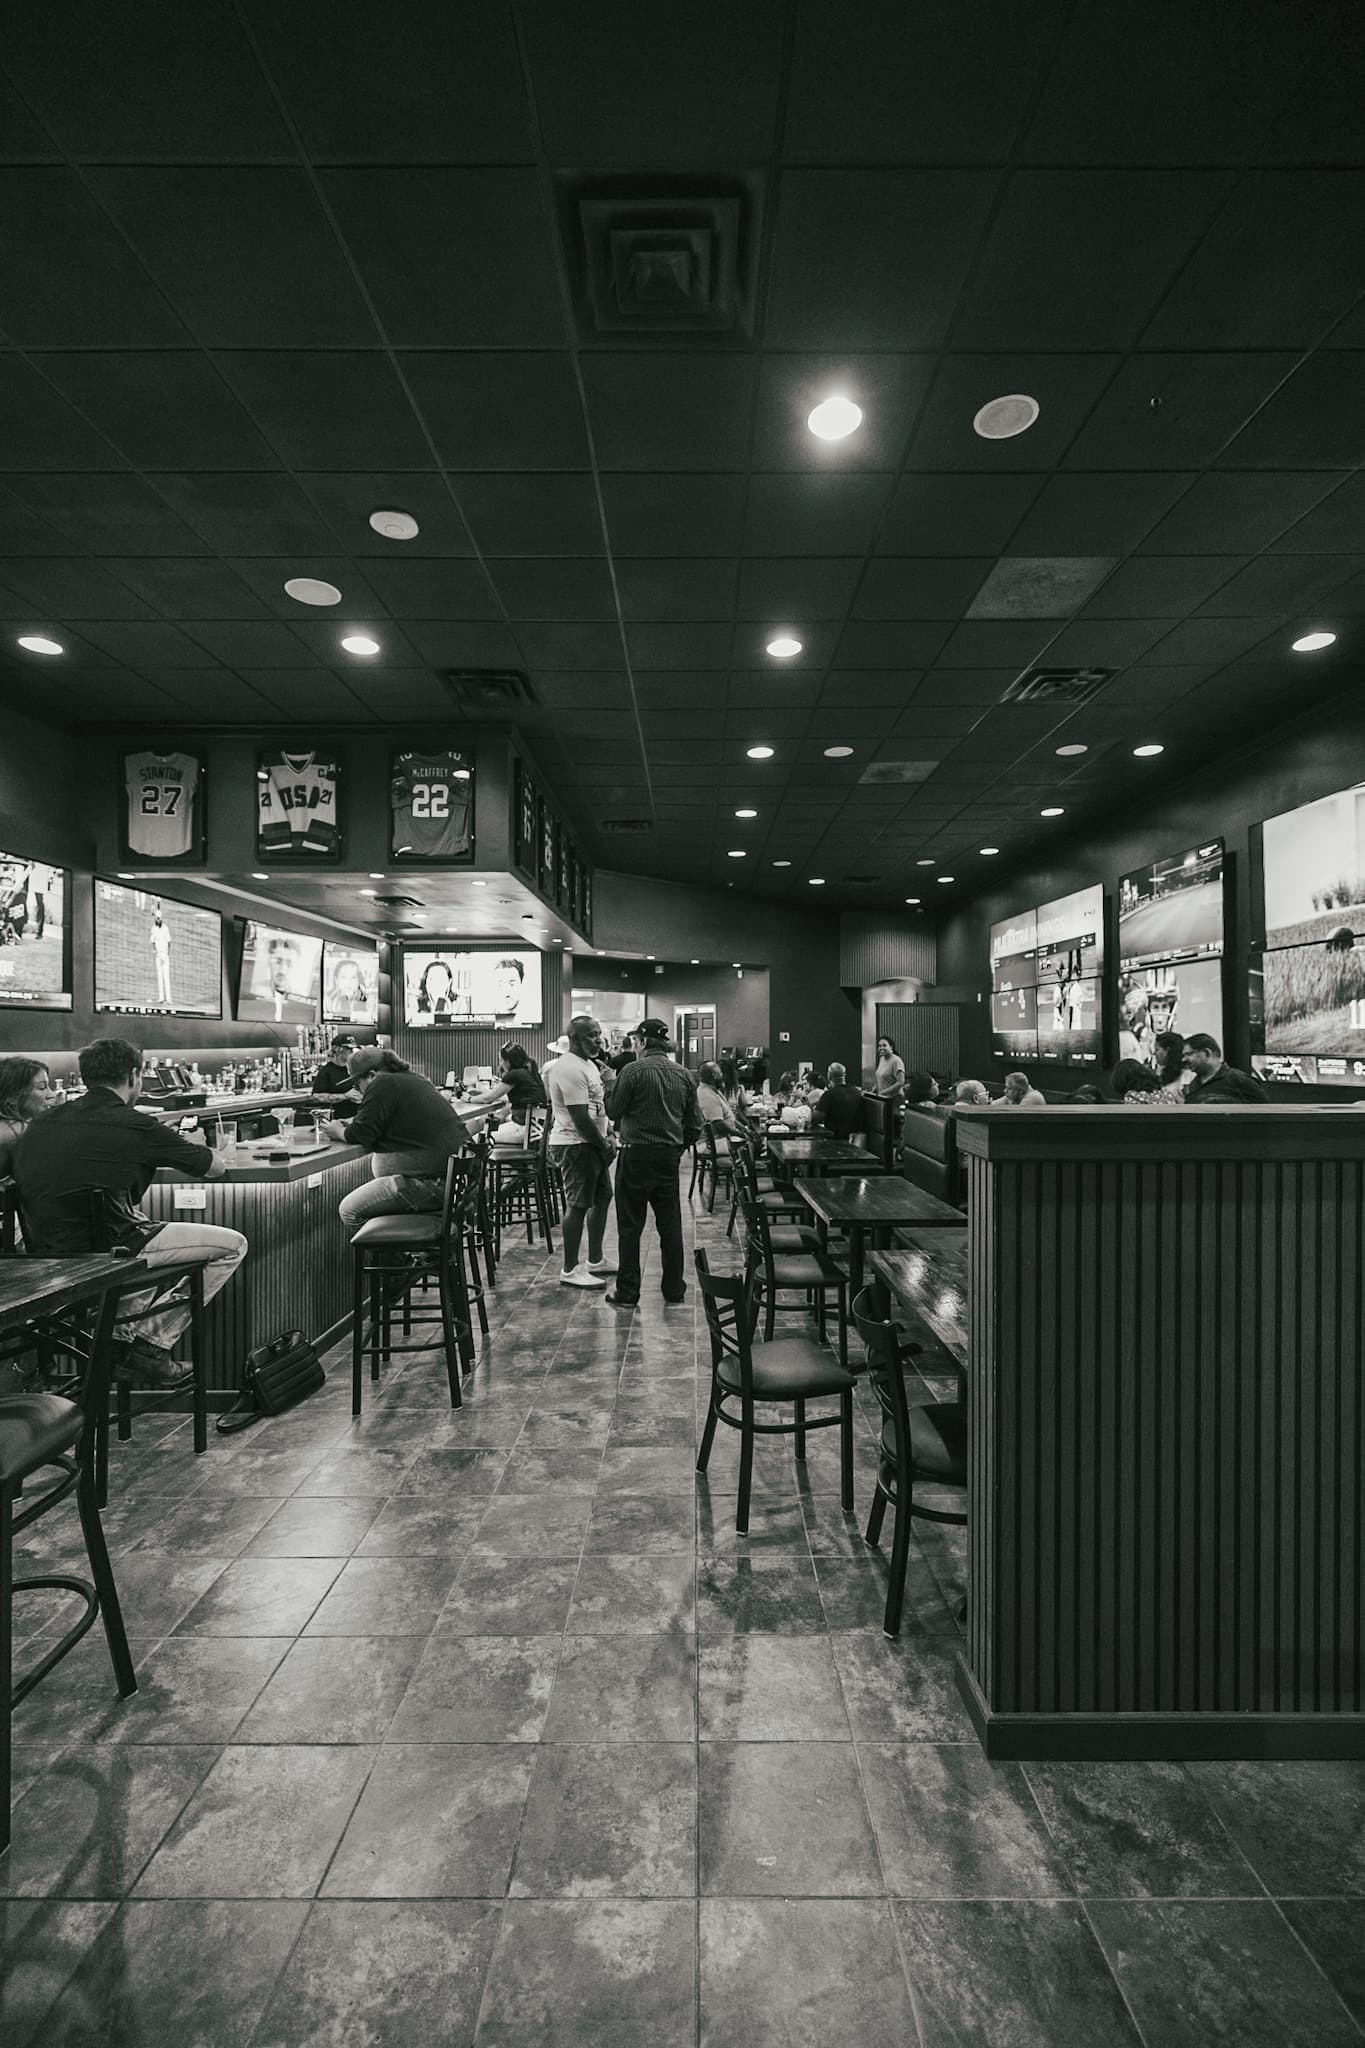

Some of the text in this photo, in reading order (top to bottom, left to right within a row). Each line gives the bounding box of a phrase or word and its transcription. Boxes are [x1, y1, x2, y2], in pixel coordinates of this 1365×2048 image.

[140, 767, 184, 782] STANTON
[140, 784, 183, 817] 27
[320, 789, 333, 805] 21
[412, 784, 449, 818] 22
